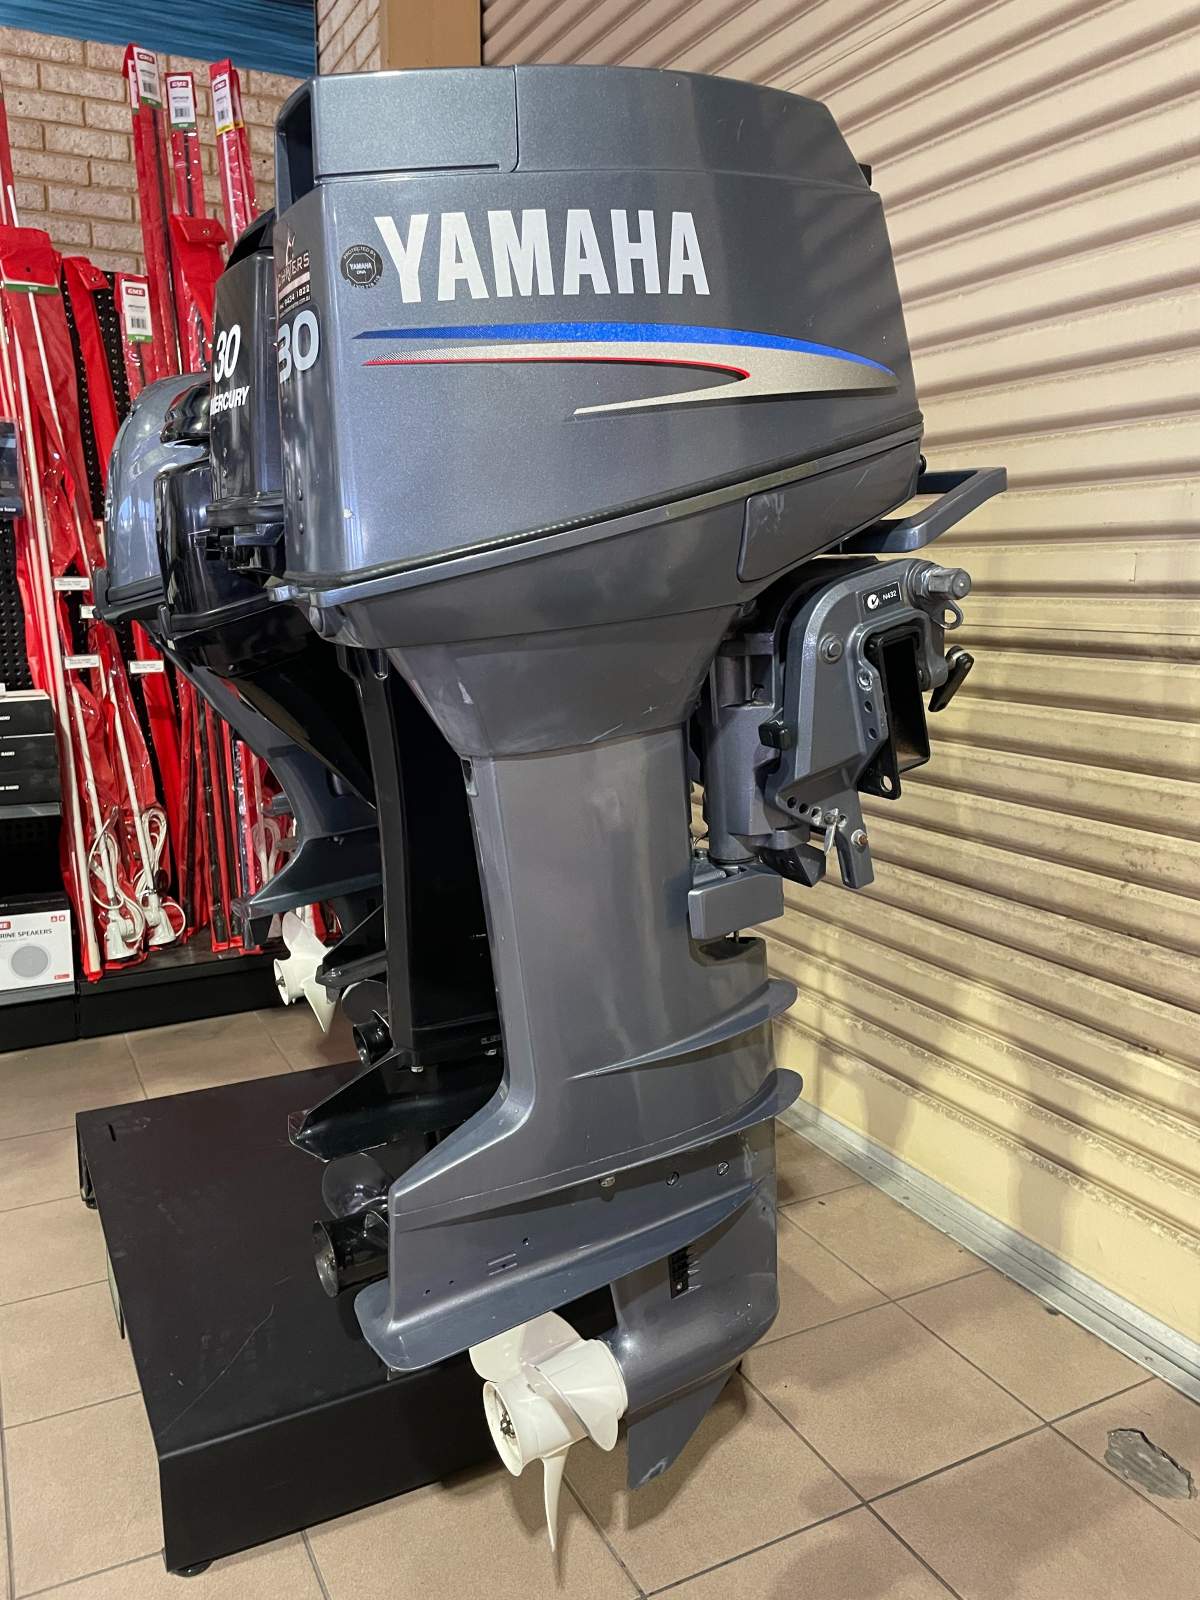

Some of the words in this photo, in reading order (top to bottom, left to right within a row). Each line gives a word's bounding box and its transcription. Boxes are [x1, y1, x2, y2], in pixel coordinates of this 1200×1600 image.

[374, 208, 711, 304] YAMAHA
[349, 262, 373, 270] YAMAHA
[214, 324, 241, 383] 30
[882, 589, 897, 600] N432
[18, 928, 53, 937] SPEAKERS
